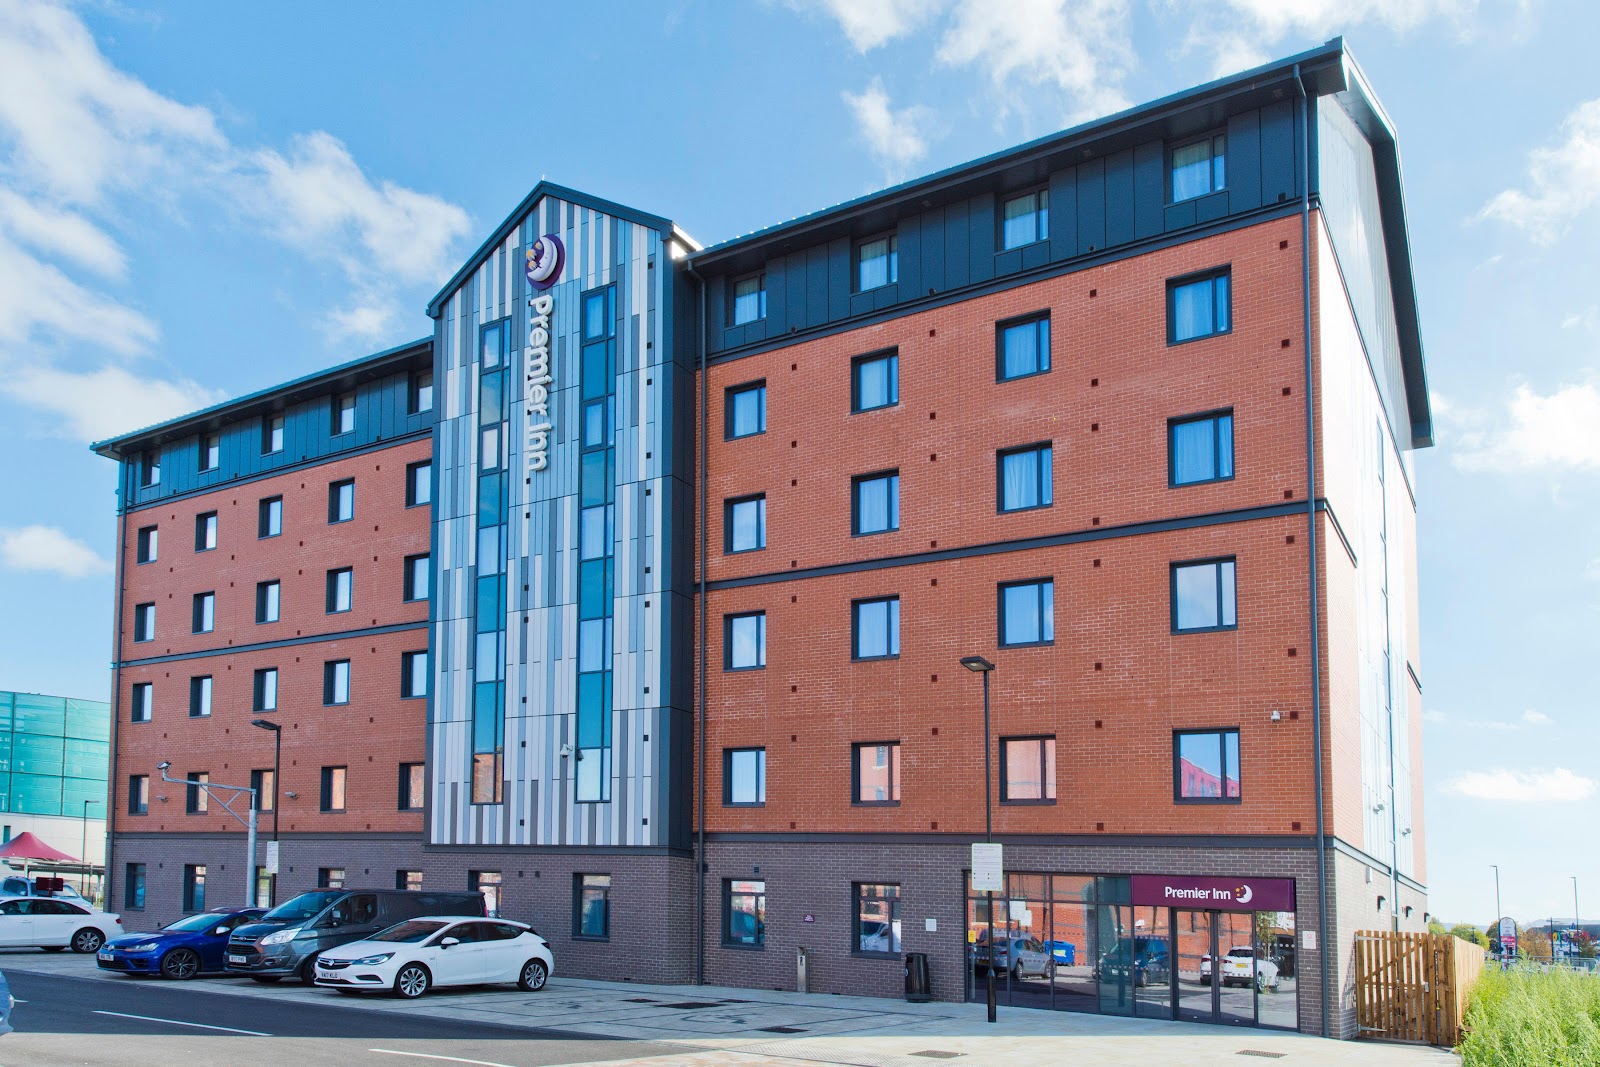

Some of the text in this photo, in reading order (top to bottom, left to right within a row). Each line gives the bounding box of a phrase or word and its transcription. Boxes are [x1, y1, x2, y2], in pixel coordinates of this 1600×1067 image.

[528, 294, 553, 471] Premier Inn
[1165, 886, 1231, 900] Premier Inn
